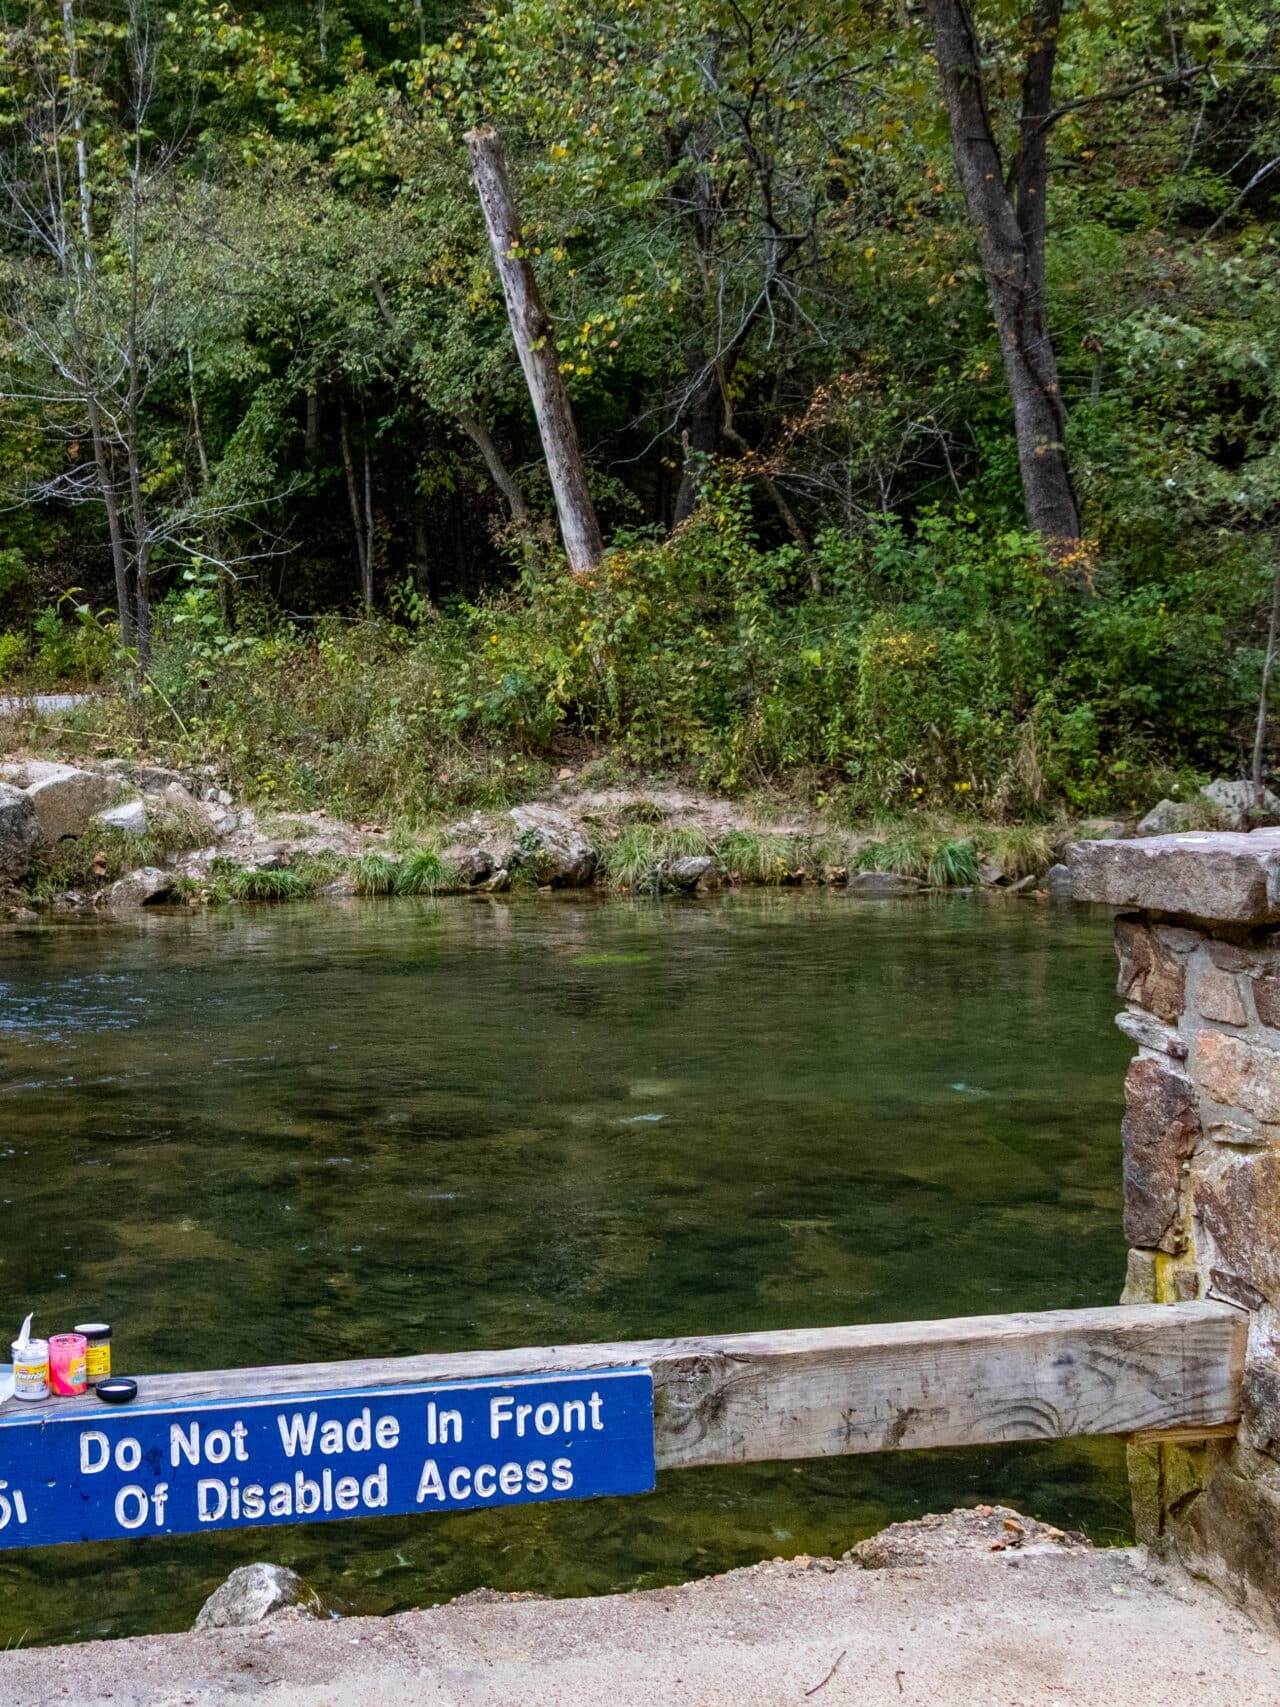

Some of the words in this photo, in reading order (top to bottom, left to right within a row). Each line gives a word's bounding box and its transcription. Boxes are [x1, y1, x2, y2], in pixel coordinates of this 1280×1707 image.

[80, 1431, 142, 1474] Do
[170, 1420, 249, 1467] Not
[278, 1405, 401, 1457] Wade
[428, 1401, 463, 1445] In
[489, 1391, 606, 1440] Front
[115, 1482, 169, 1530] Of
[198, 1463, 389, 1523] Disabled
[416, 1457, 575, 1504] Access
